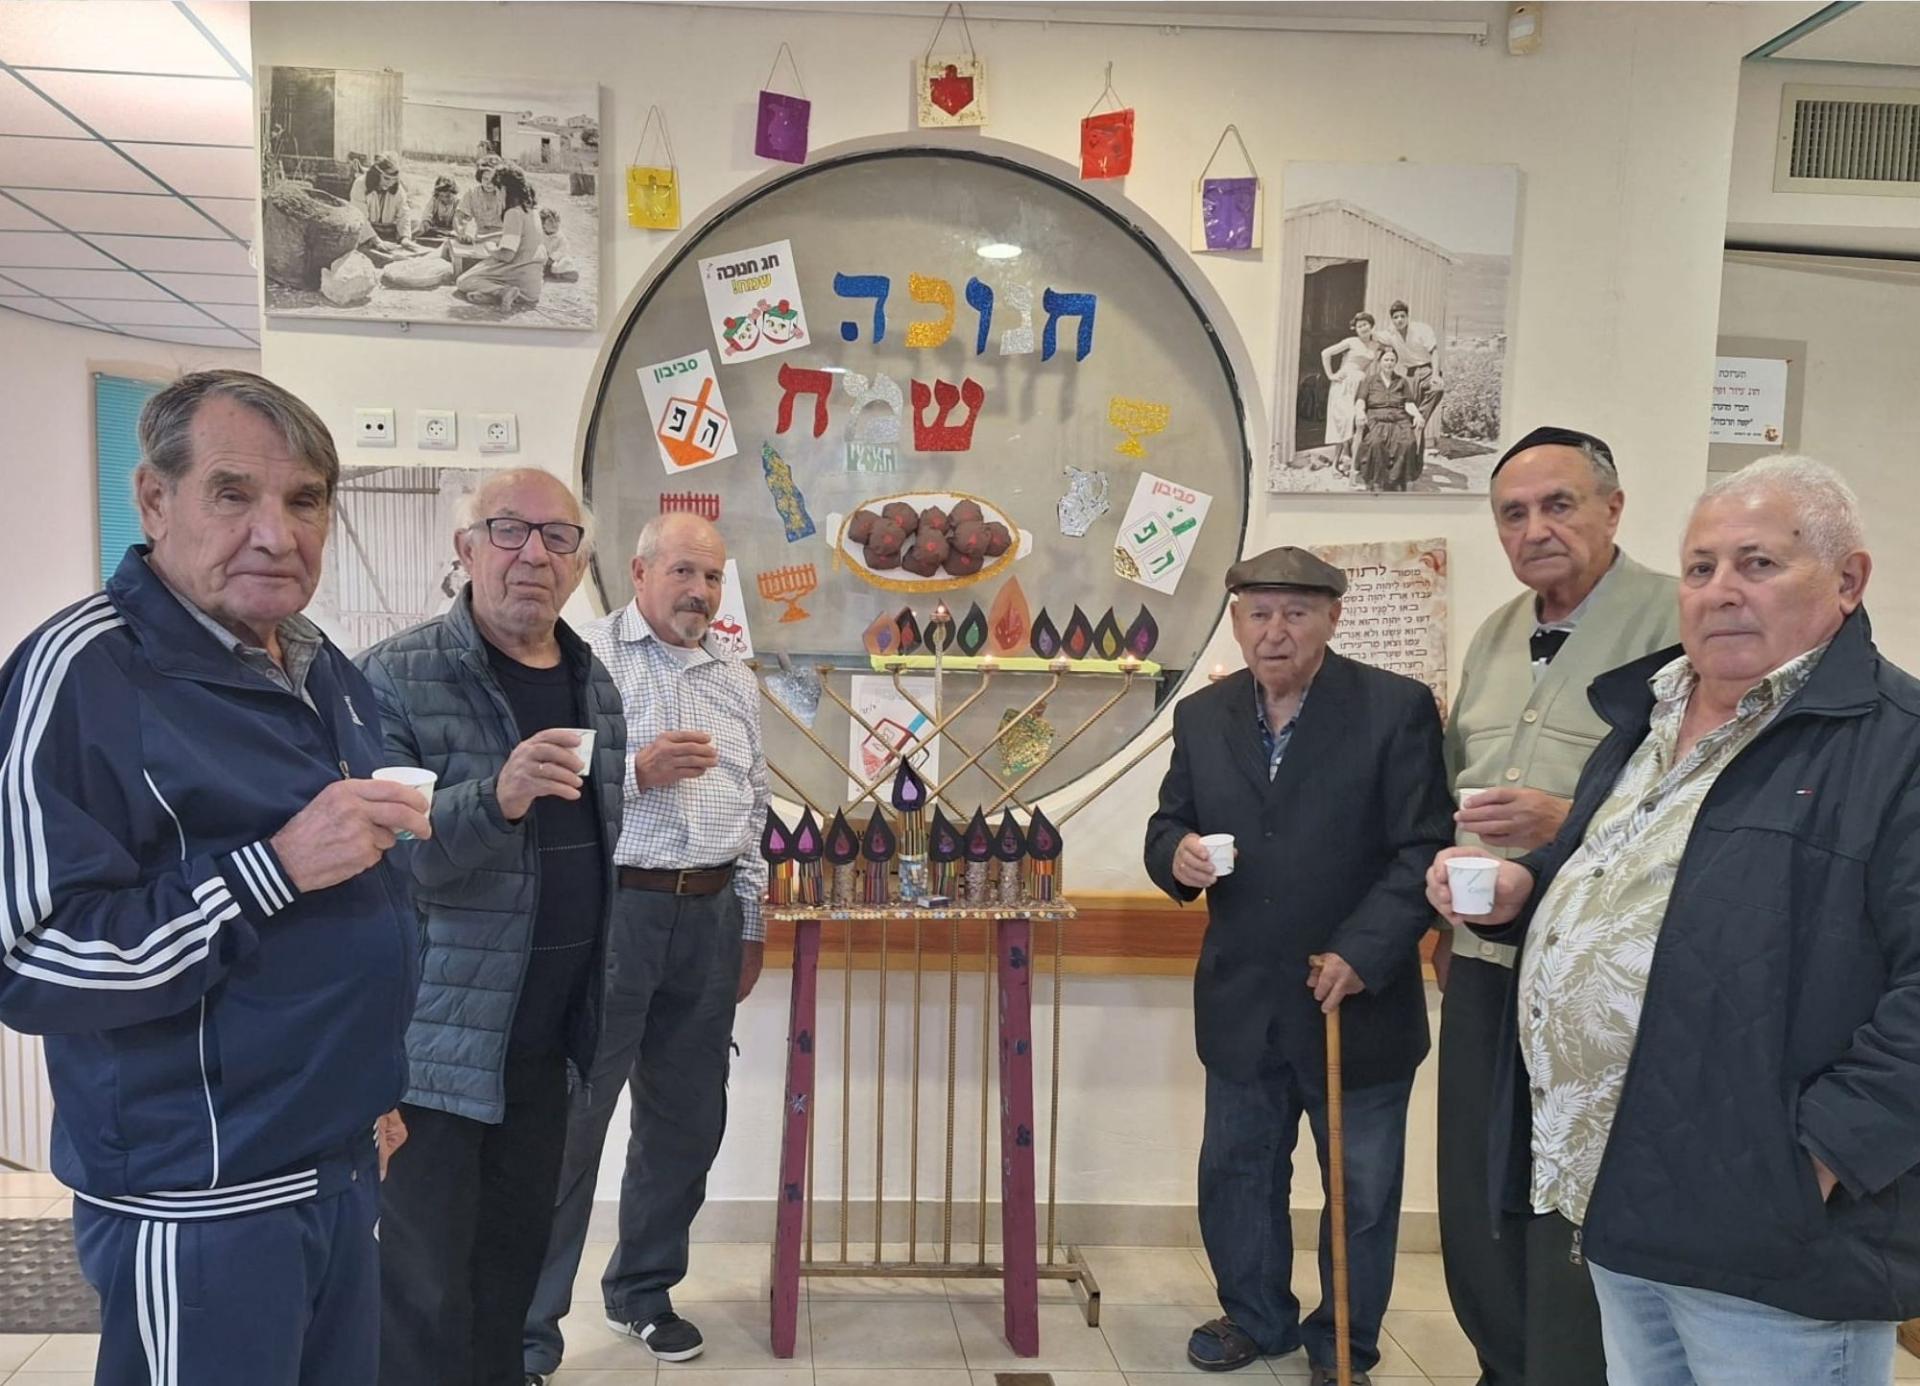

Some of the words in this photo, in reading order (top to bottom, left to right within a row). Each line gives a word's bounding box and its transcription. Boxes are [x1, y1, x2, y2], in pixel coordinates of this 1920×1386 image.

[716, 260, 759, 280] חנוכה
[761, 254, 780, 271] חג
[833, 272, 1097, 362] חנוכה
[653, 358, 699, 383] סביבון
[1152, 481, 1196, 504] סביבון
[1347, 563, 1387, 579] לתוד
